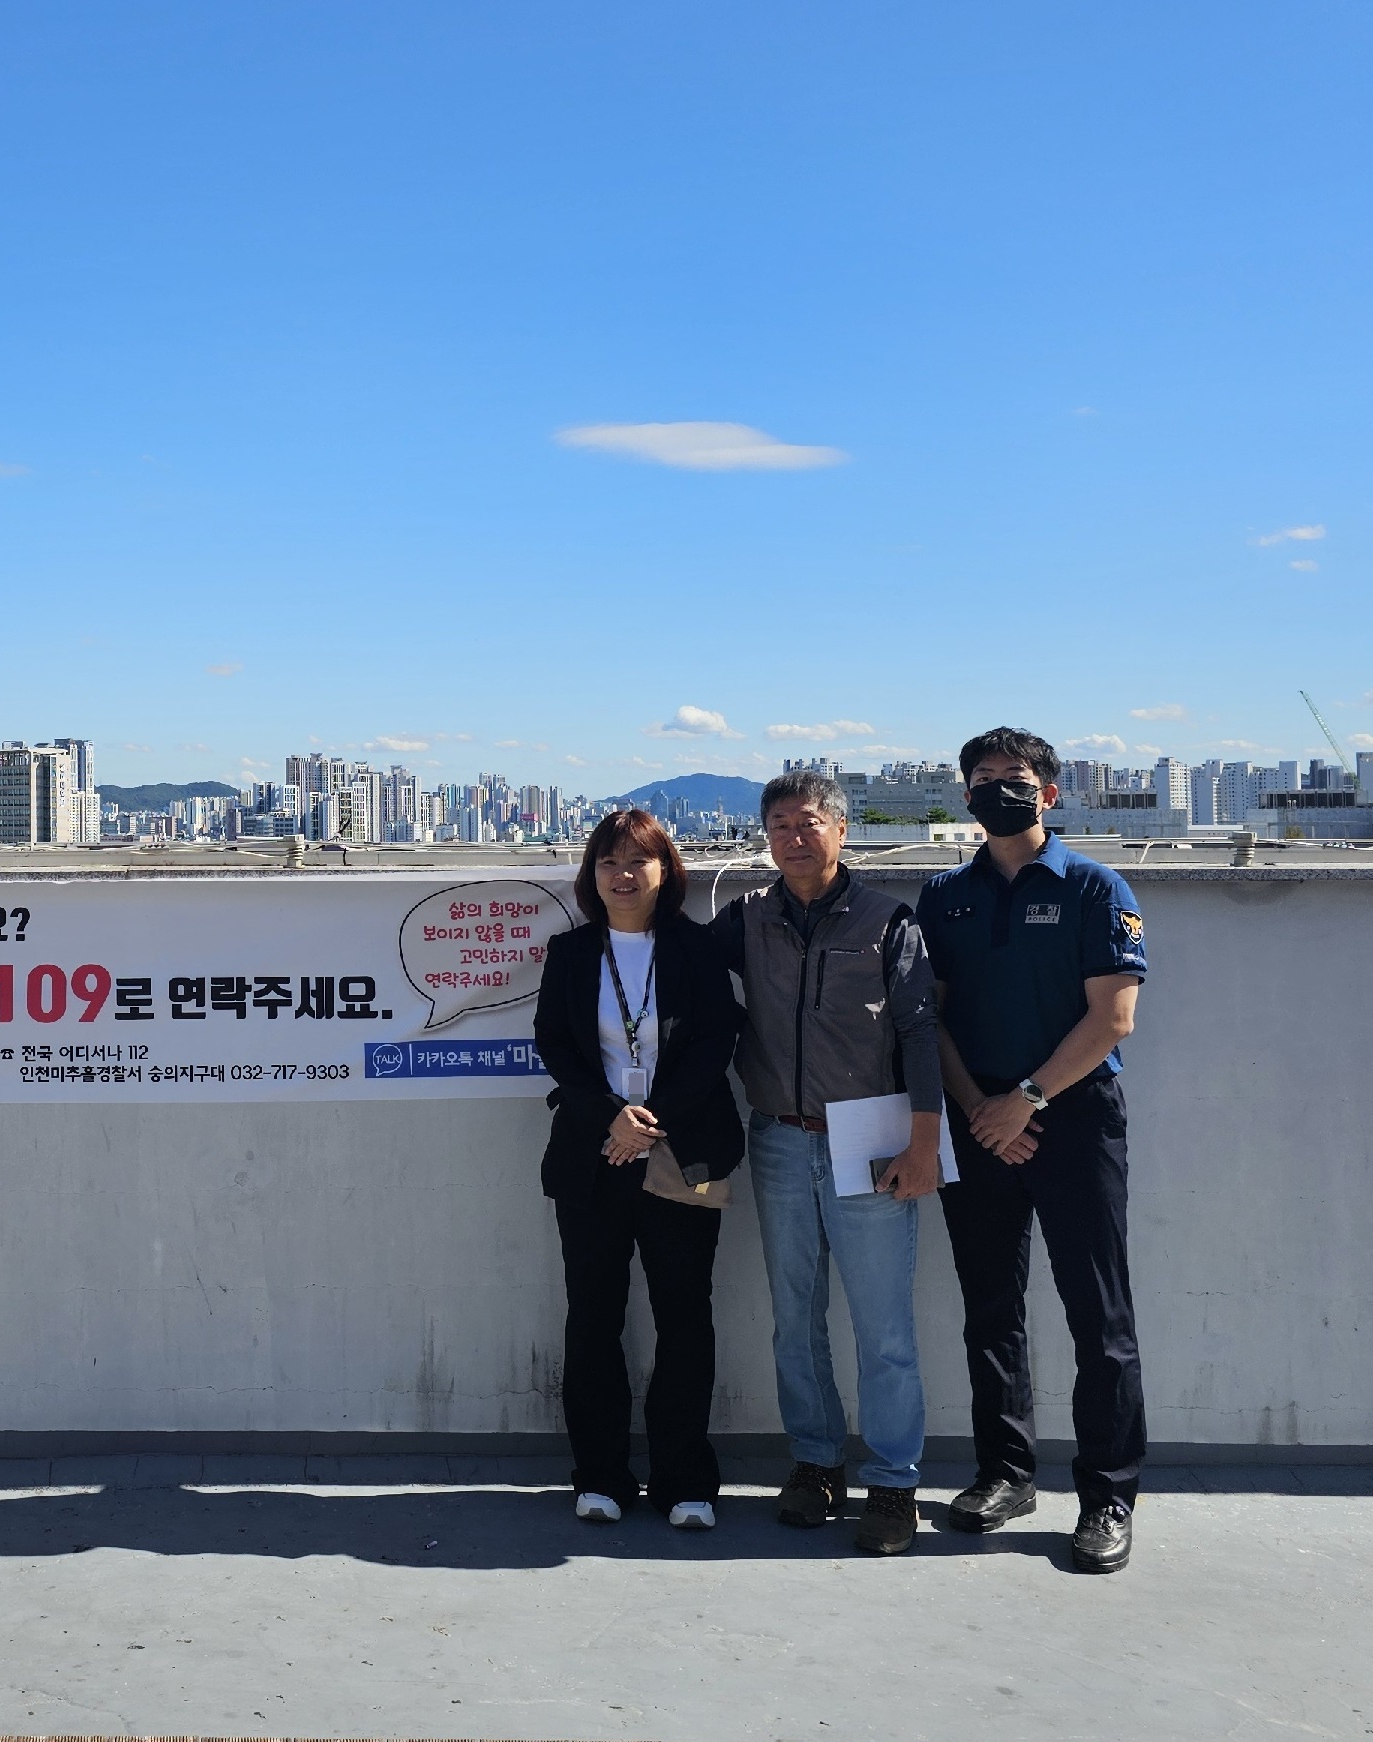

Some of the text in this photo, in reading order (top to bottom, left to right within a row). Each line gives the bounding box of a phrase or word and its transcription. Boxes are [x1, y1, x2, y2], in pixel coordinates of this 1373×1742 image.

[449, 901, 539, 920] 삶의 희망이
[424, 922, 531, 943] 보이지 않을 때
[460, 948, 524, 965] 고민하지
[425, 971, 510, 989] 연락주세요!
[168, 976, 394, 1020] 연락주세요.
[21, 1044, 149, 1062] 전국 어디서나 112
[376, 1054, 401, 1065] TALK
[417, 1051, 474, 1068] 카카오톡
[478, 1050, 506, 1066] 채널
[20, 1065, 350, 1083] 인천미추홀경찰서 숭의지구대 032-717-9303
